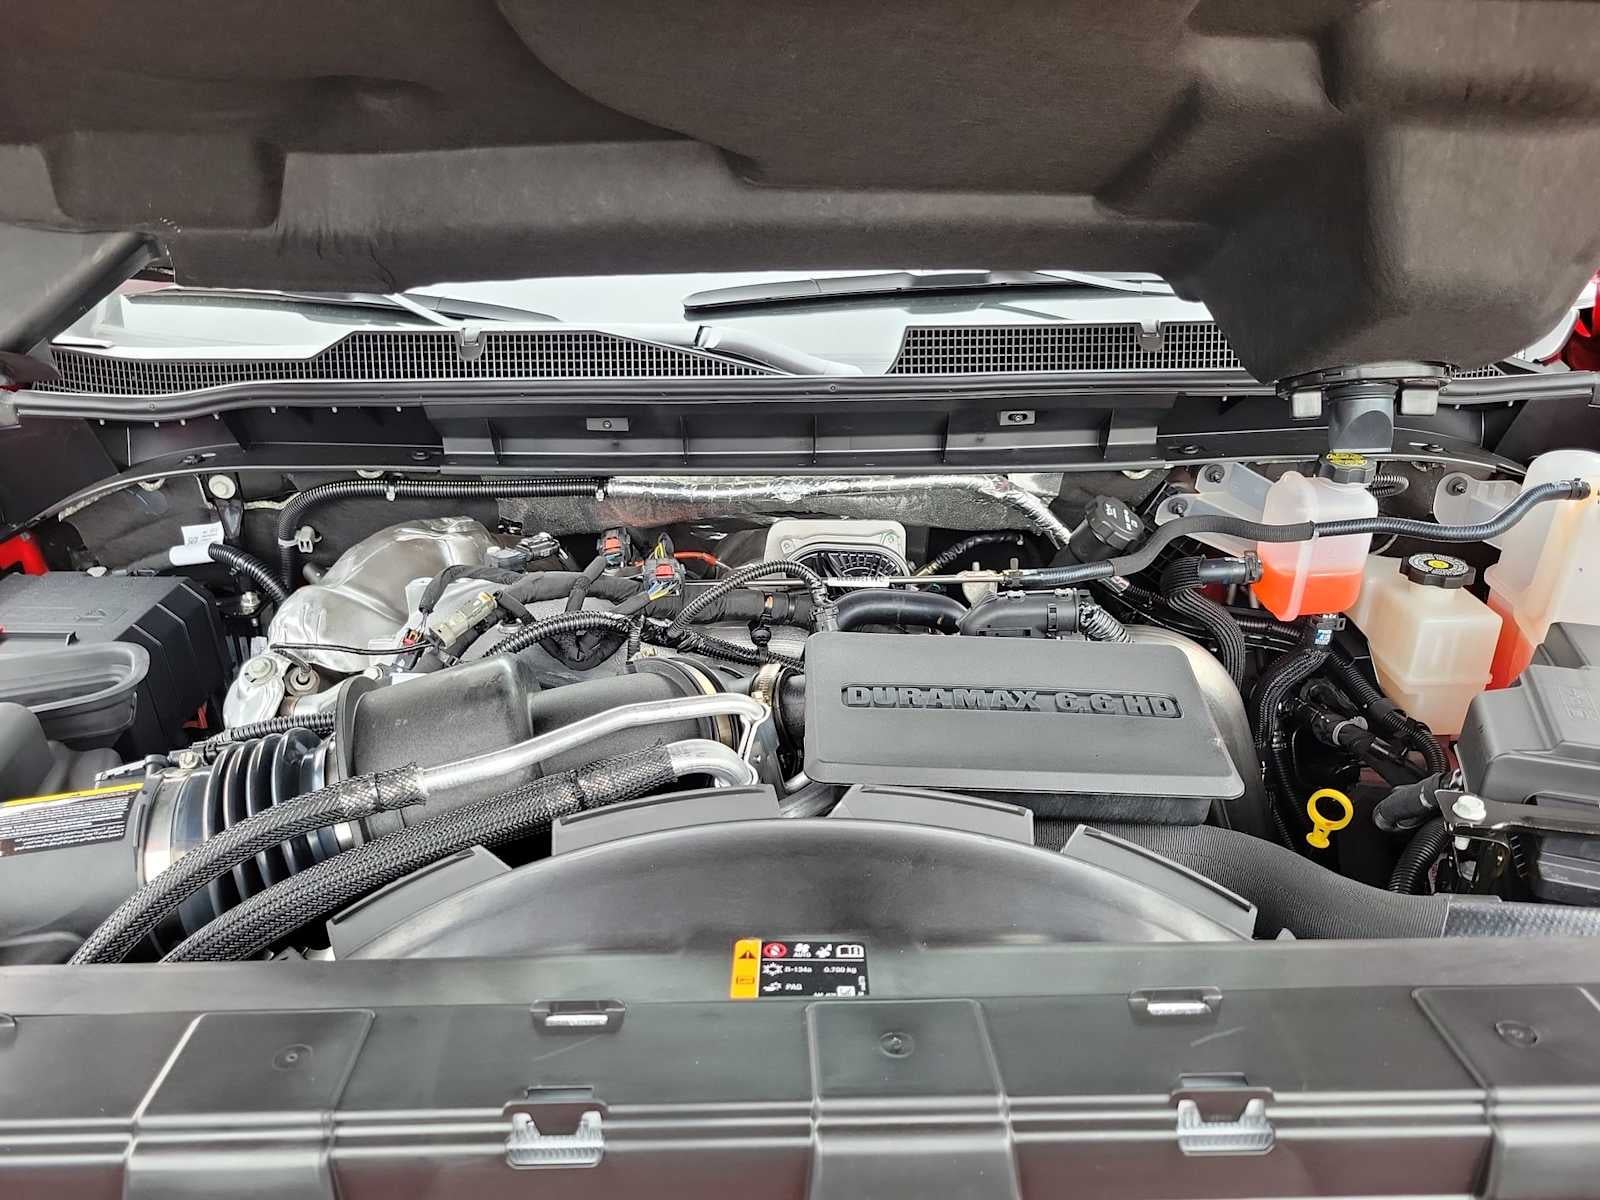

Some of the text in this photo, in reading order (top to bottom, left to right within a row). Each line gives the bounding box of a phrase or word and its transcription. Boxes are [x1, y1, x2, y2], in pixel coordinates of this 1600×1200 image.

[846, 686, 1181, 718] DURAMAX 6.6 HD
[847, 966, 857, 974] kg
